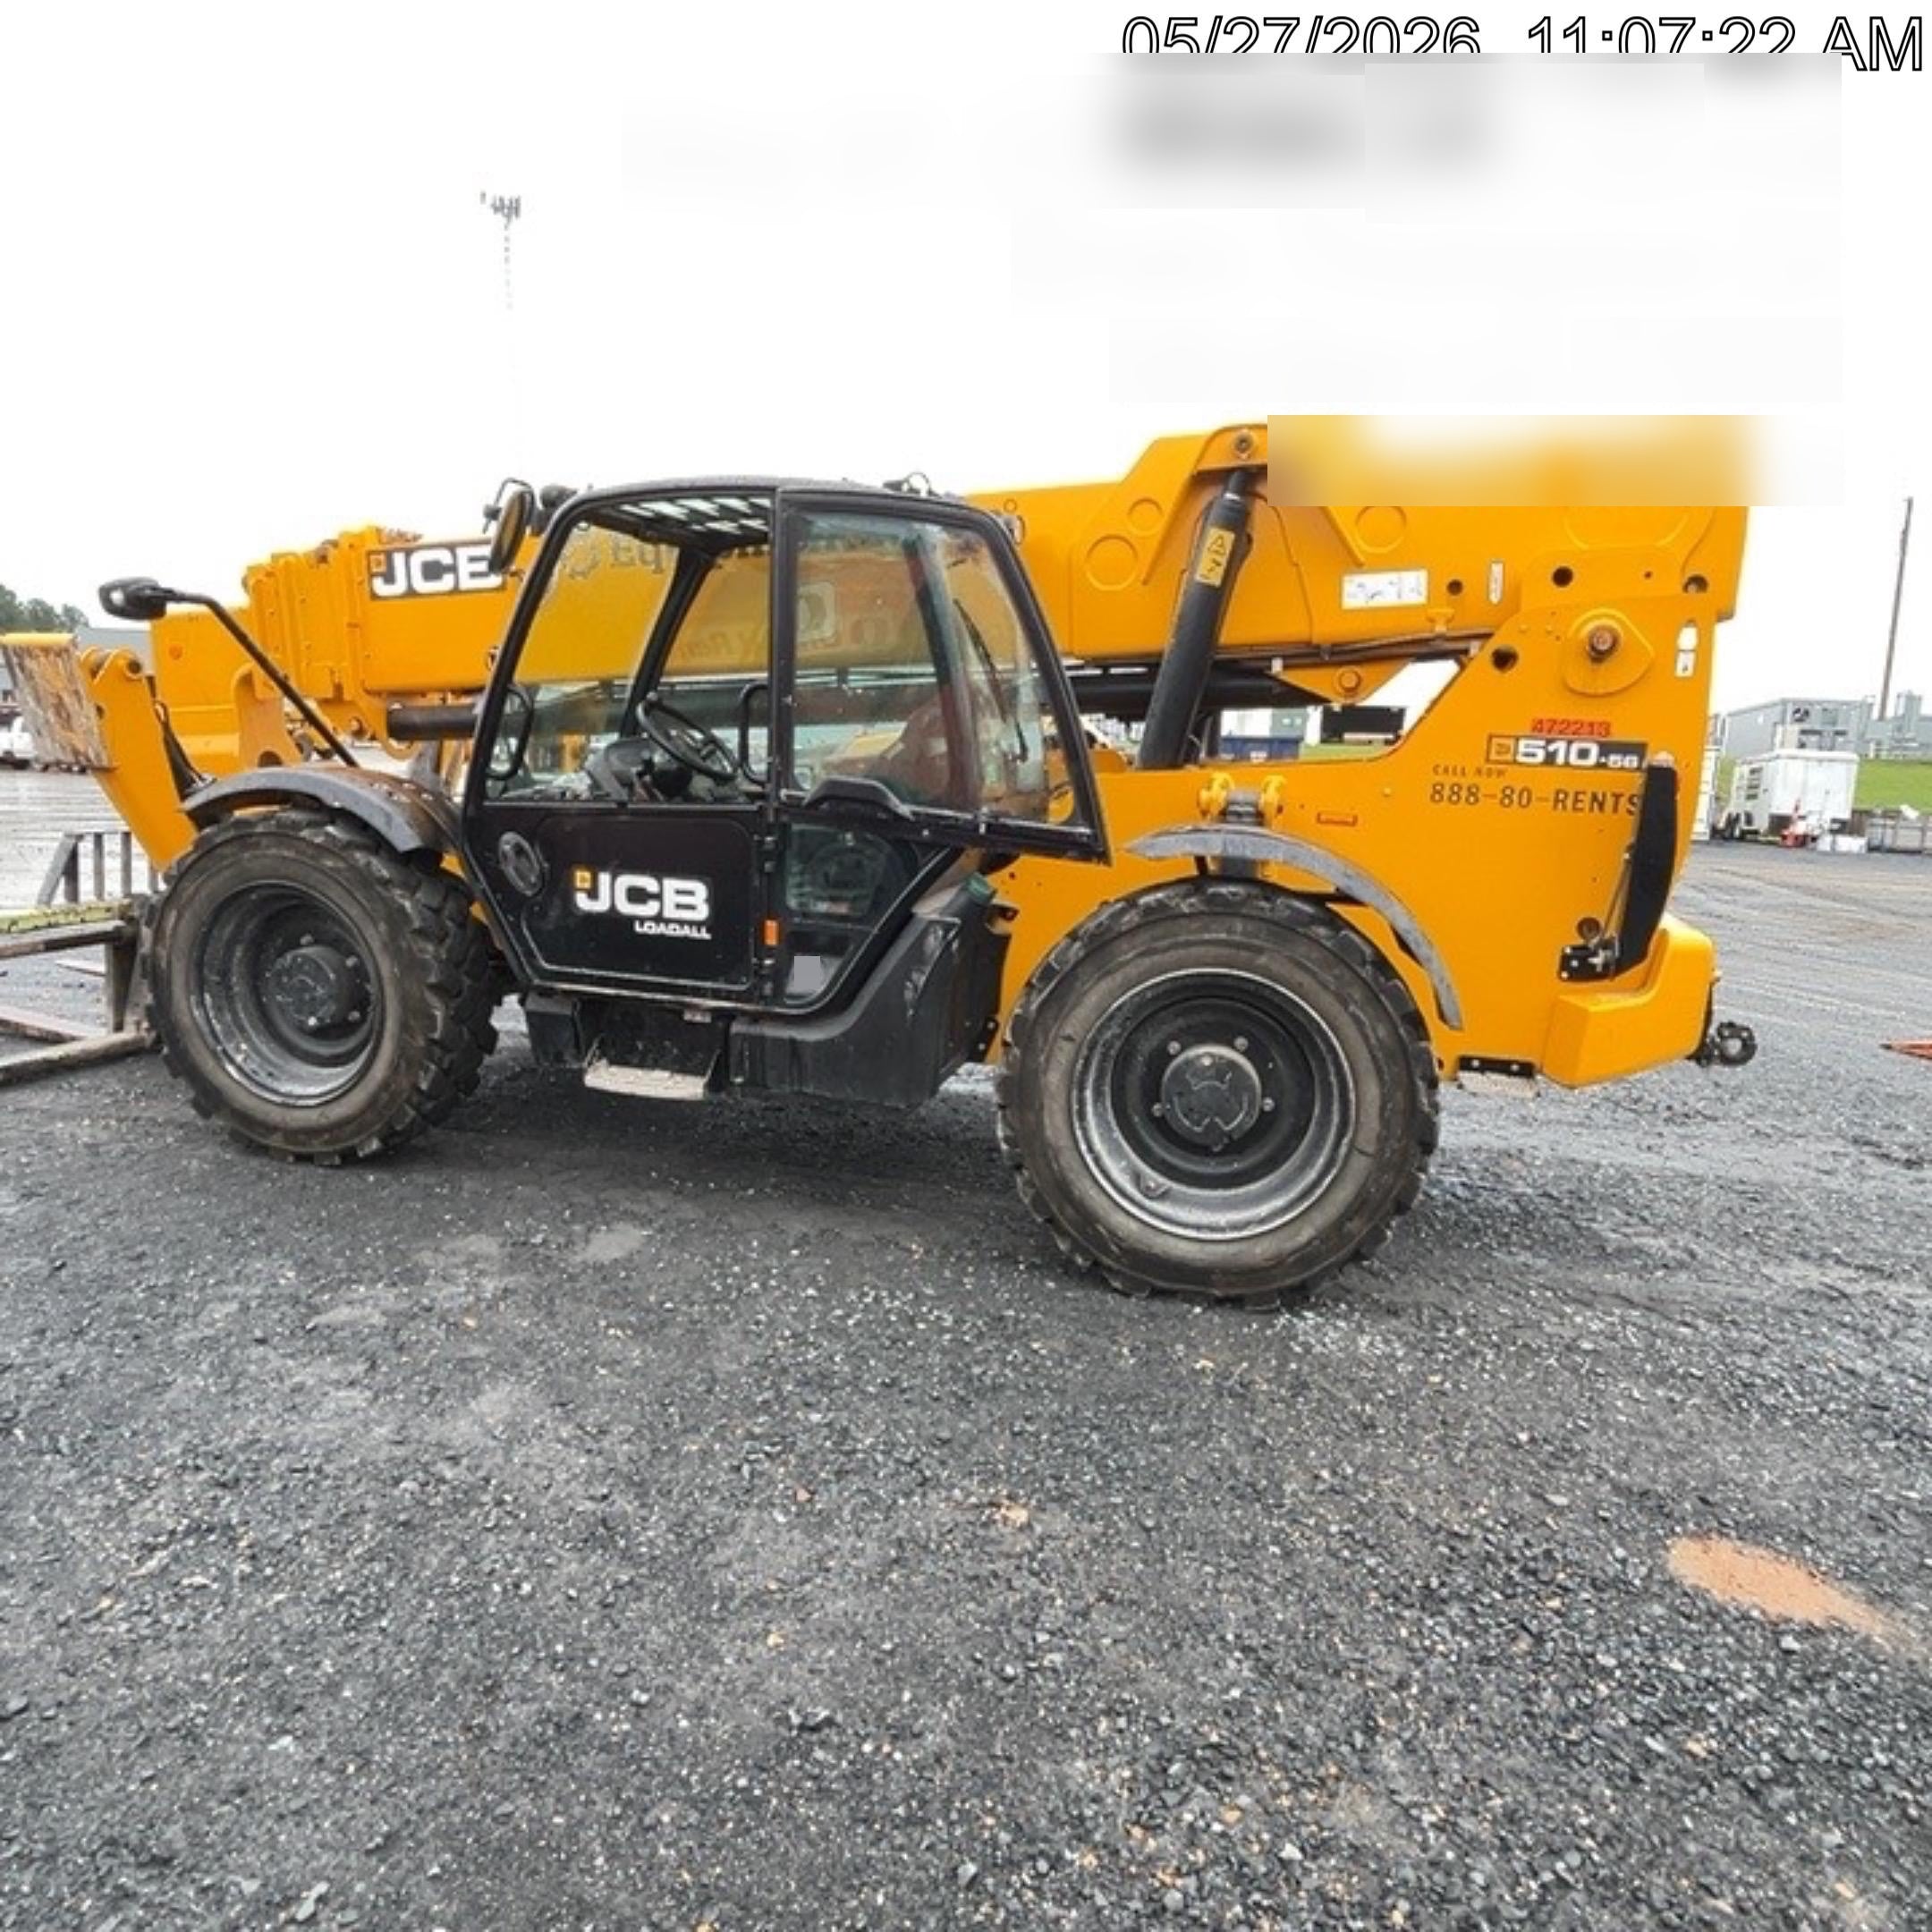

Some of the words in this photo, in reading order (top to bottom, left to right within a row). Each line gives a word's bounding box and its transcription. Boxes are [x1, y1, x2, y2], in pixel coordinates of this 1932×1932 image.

[372, 544, 503, 597] JCB
[575, 870, 709, 921] JCB
[633, 919, 712, 940] LOADALL
